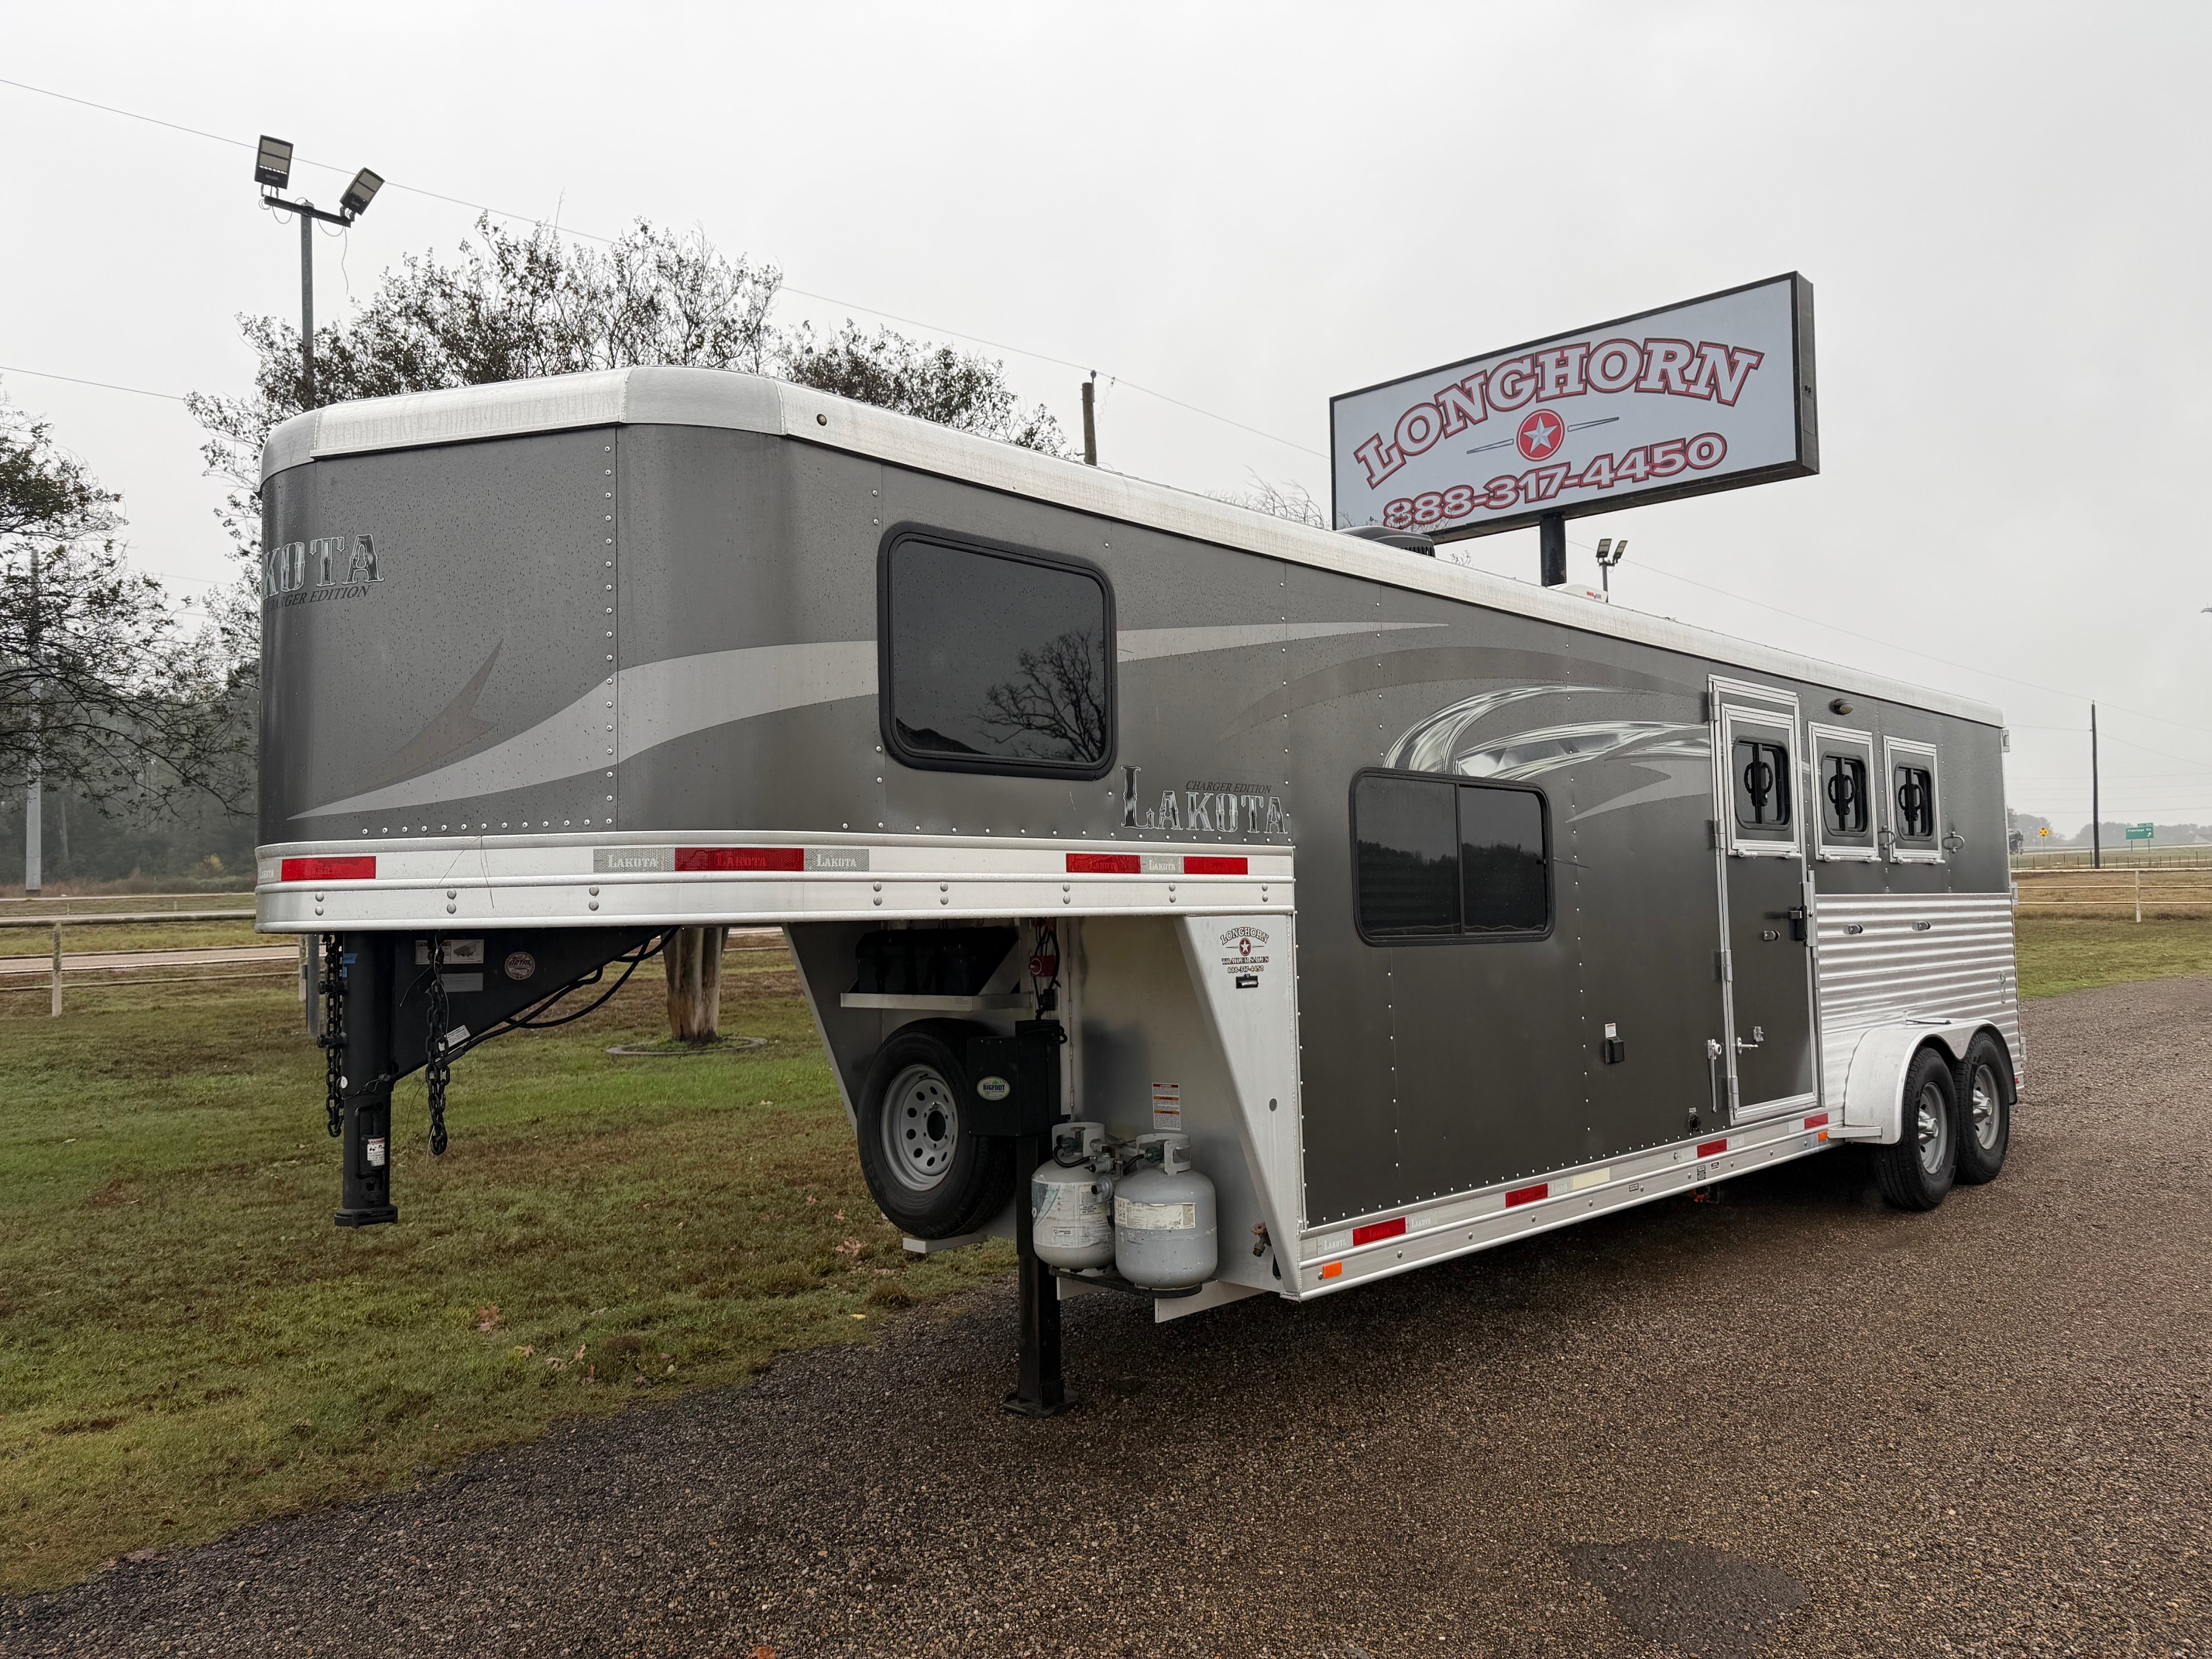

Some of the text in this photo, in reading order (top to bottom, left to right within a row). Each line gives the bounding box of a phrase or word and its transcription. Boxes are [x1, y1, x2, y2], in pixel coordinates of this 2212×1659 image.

[1354, 338, 1764, 489] LONGHORN
[1383, 431, 1728, 529] 888-317-4450
[308, 586, 371, 603] EDITION
[1186, 780, 1273, 794] CHARGER EDITION
[1120, 765, 1288, 834] LAKOTA
[608, 848, 658, 867] LAKOTA
[717, 853, 767, 867] LAKOTA
[816, 850, 857, 867] LAKOTA
[1149, 859, 1176, 871] LAKOTA
[1220, 926, 1269, 945] LONGHORN
[1221, 956, 1269, 965] TRAILER SALES
[1228, 965, 1264, 974] 888-317-4450
[1411, 1218, 1431, 1228] LAKOTA
[1324, 1239, 1347, 1251] LAKOTA
